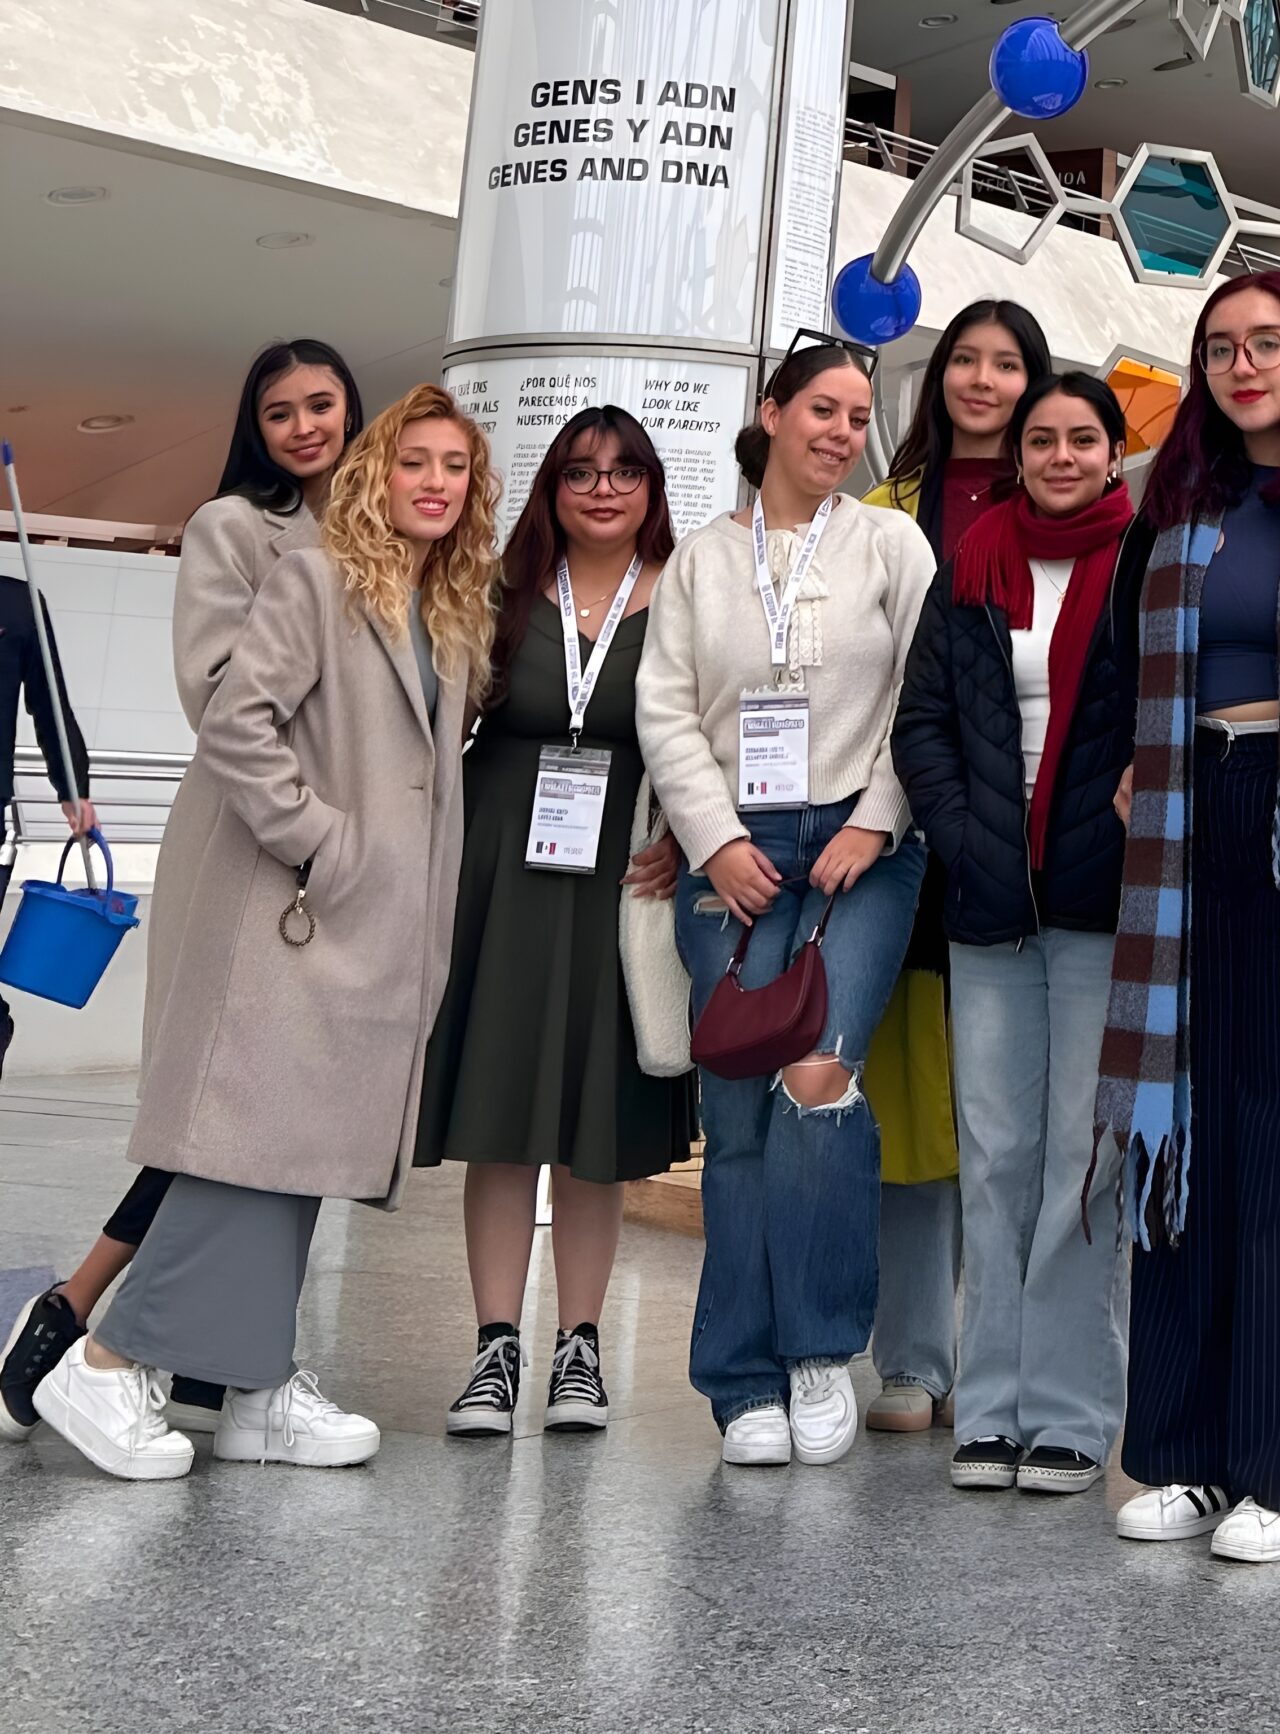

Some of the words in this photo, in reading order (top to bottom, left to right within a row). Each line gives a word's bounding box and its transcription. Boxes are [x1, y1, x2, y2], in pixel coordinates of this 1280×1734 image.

[530, 78, 622, 109] GENS
[635, 79, 645, 106] I
[657, 81, 736, 113] ADN
[513, 118, 614, 148] GENES
[627, 119, 649, 143] Y
[660, 120, 733, 151] ADN
[488, 158, 568, 190] GENES
[577, 157, 649, 182] AND
[661, 159, 730, 189] DNA
[519, 377, 546, 391] ¿POR
[574, 376, 597, 388] NOS
[644, 378, 671, 392] WHY
[674, 381, 689, 392] DO
[693, 382, 710, 394] WE
[482, 399, 499, 413] ALS
[518, 396, 578, 407] PARECEMOS
[581, 396, 589, 407] A
[642, 398, 672, 410] LOOK
[675, 399, 700, 412] LIKE
[516, 413, 569, 426] NUESTROS
[640, 416, 665, 428] OUR
[667, 418, 720, 433] PARENTS?
